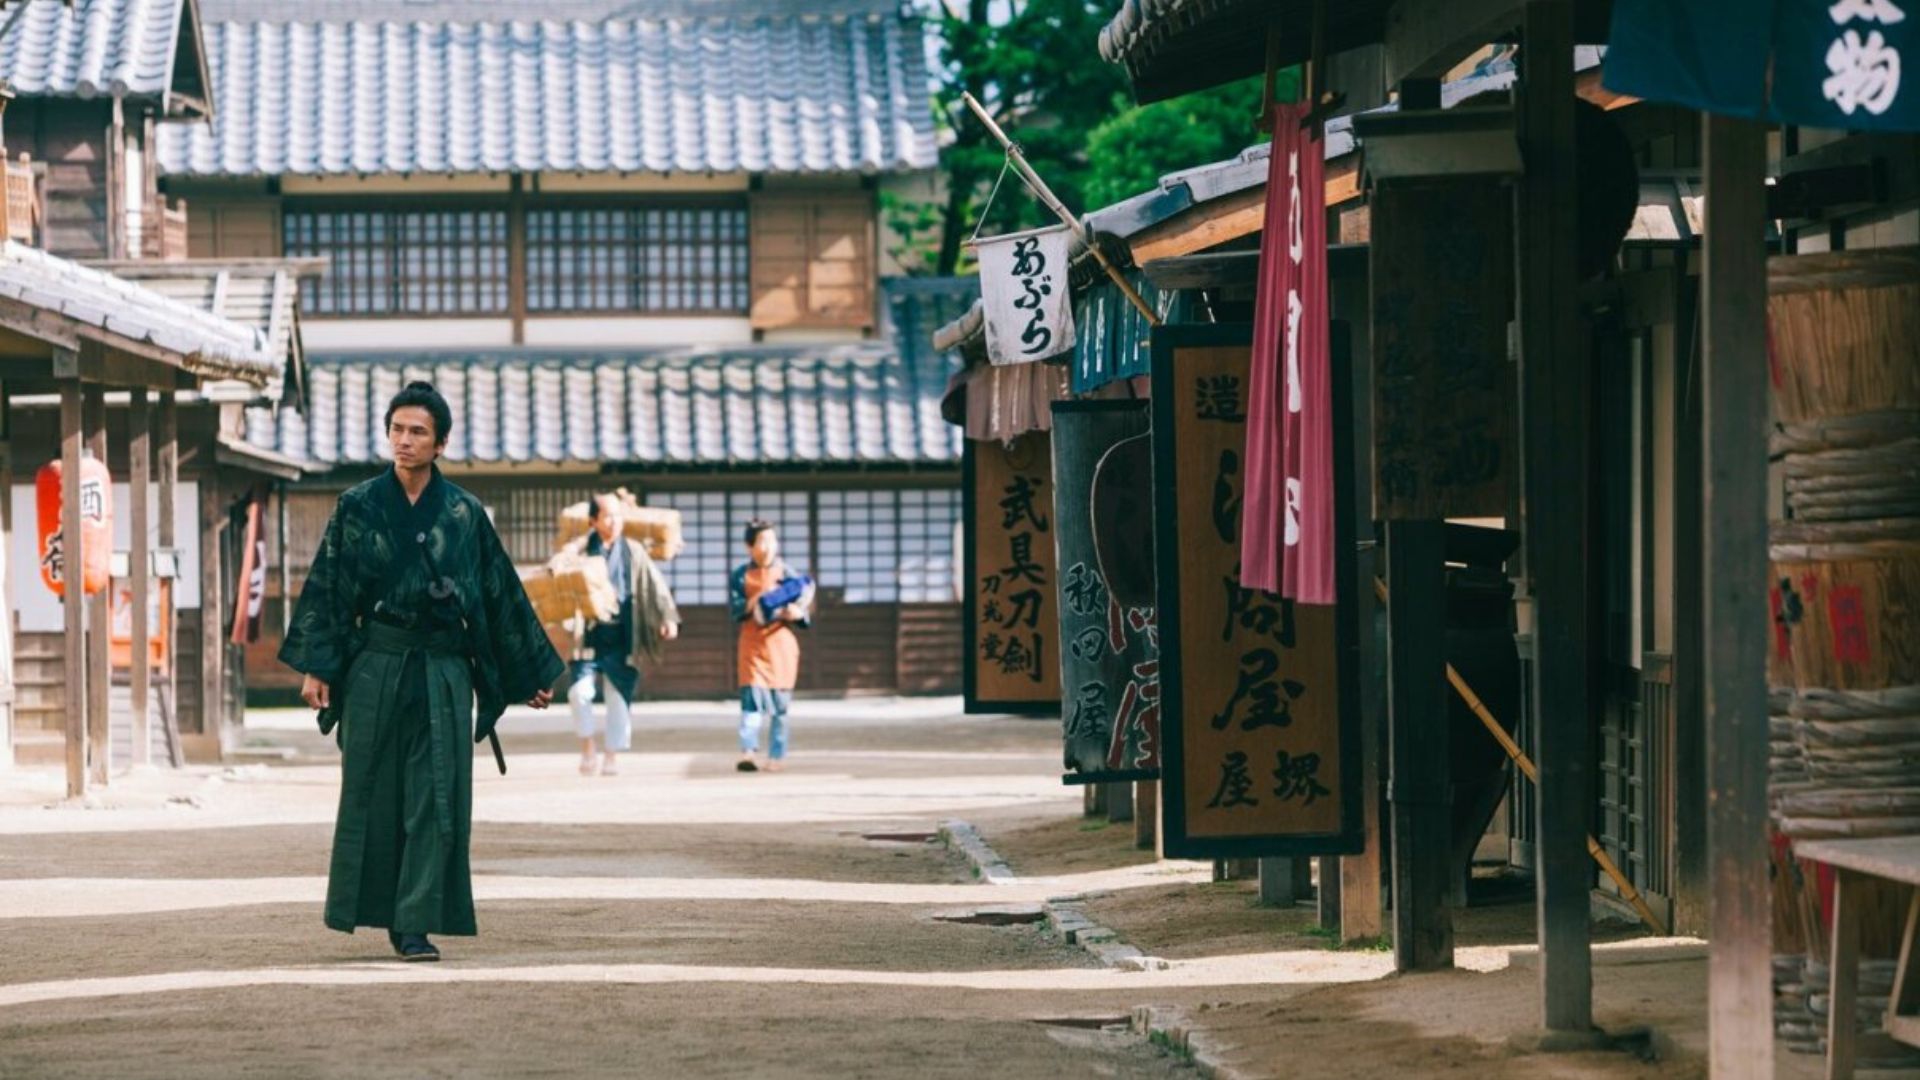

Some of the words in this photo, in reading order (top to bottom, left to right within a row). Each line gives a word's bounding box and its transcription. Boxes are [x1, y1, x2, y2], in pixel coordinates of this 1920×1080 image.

[1823, 0, 1905, 115] 物
[1012, 236, 1051, 354] あぶら
[1064, 561, 1107, 739] 秋田屋
